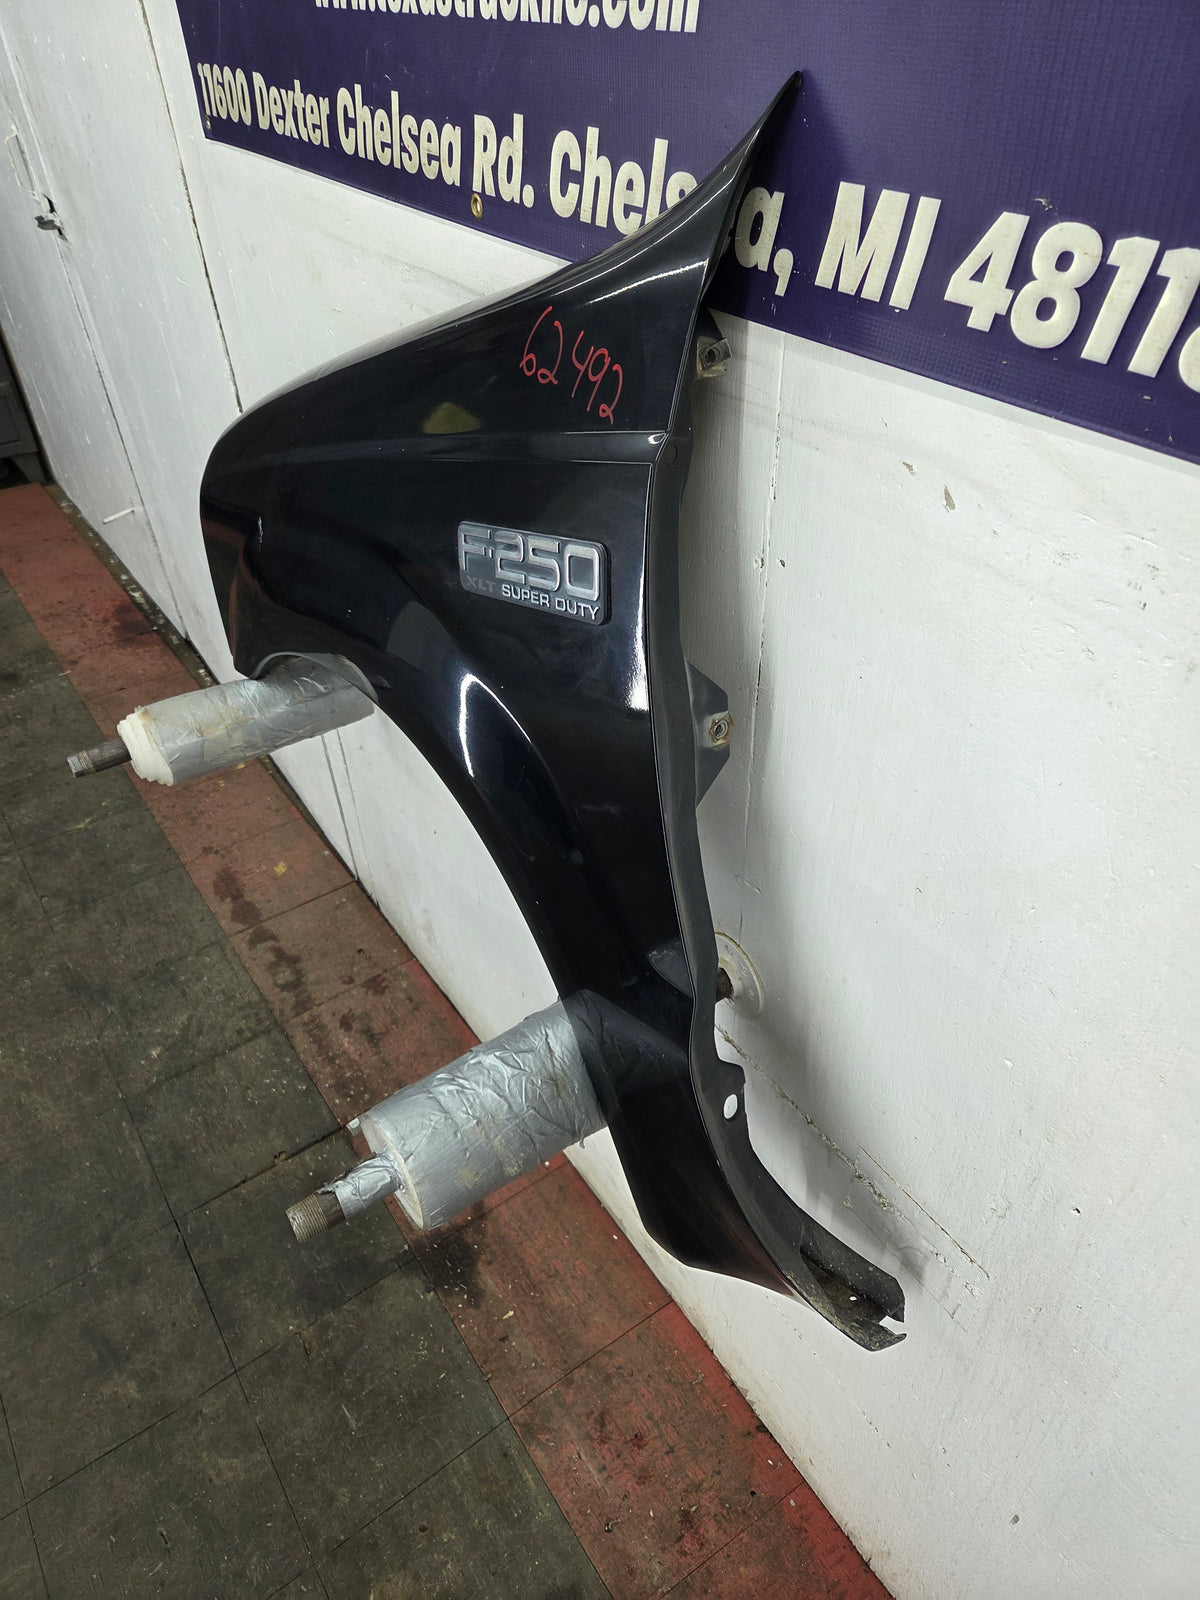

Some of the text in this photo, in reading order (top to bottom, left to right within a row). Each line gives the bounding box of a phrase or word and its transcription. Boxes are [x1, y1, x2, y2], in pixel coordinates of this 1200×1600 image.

[197, 62, 251, 126] 11600
[252, 71, 330, 148] Dexter
[336, 84, 461, 186] Chelsea
[472, 113, 534, 208] Rd.
[549, 126, 794, 297] Chela,
[815, 181, 941, 310] MI
[458, 523, 600, 601] F-250
[466, 575, 600, 620] XLT SUPER DUTY
